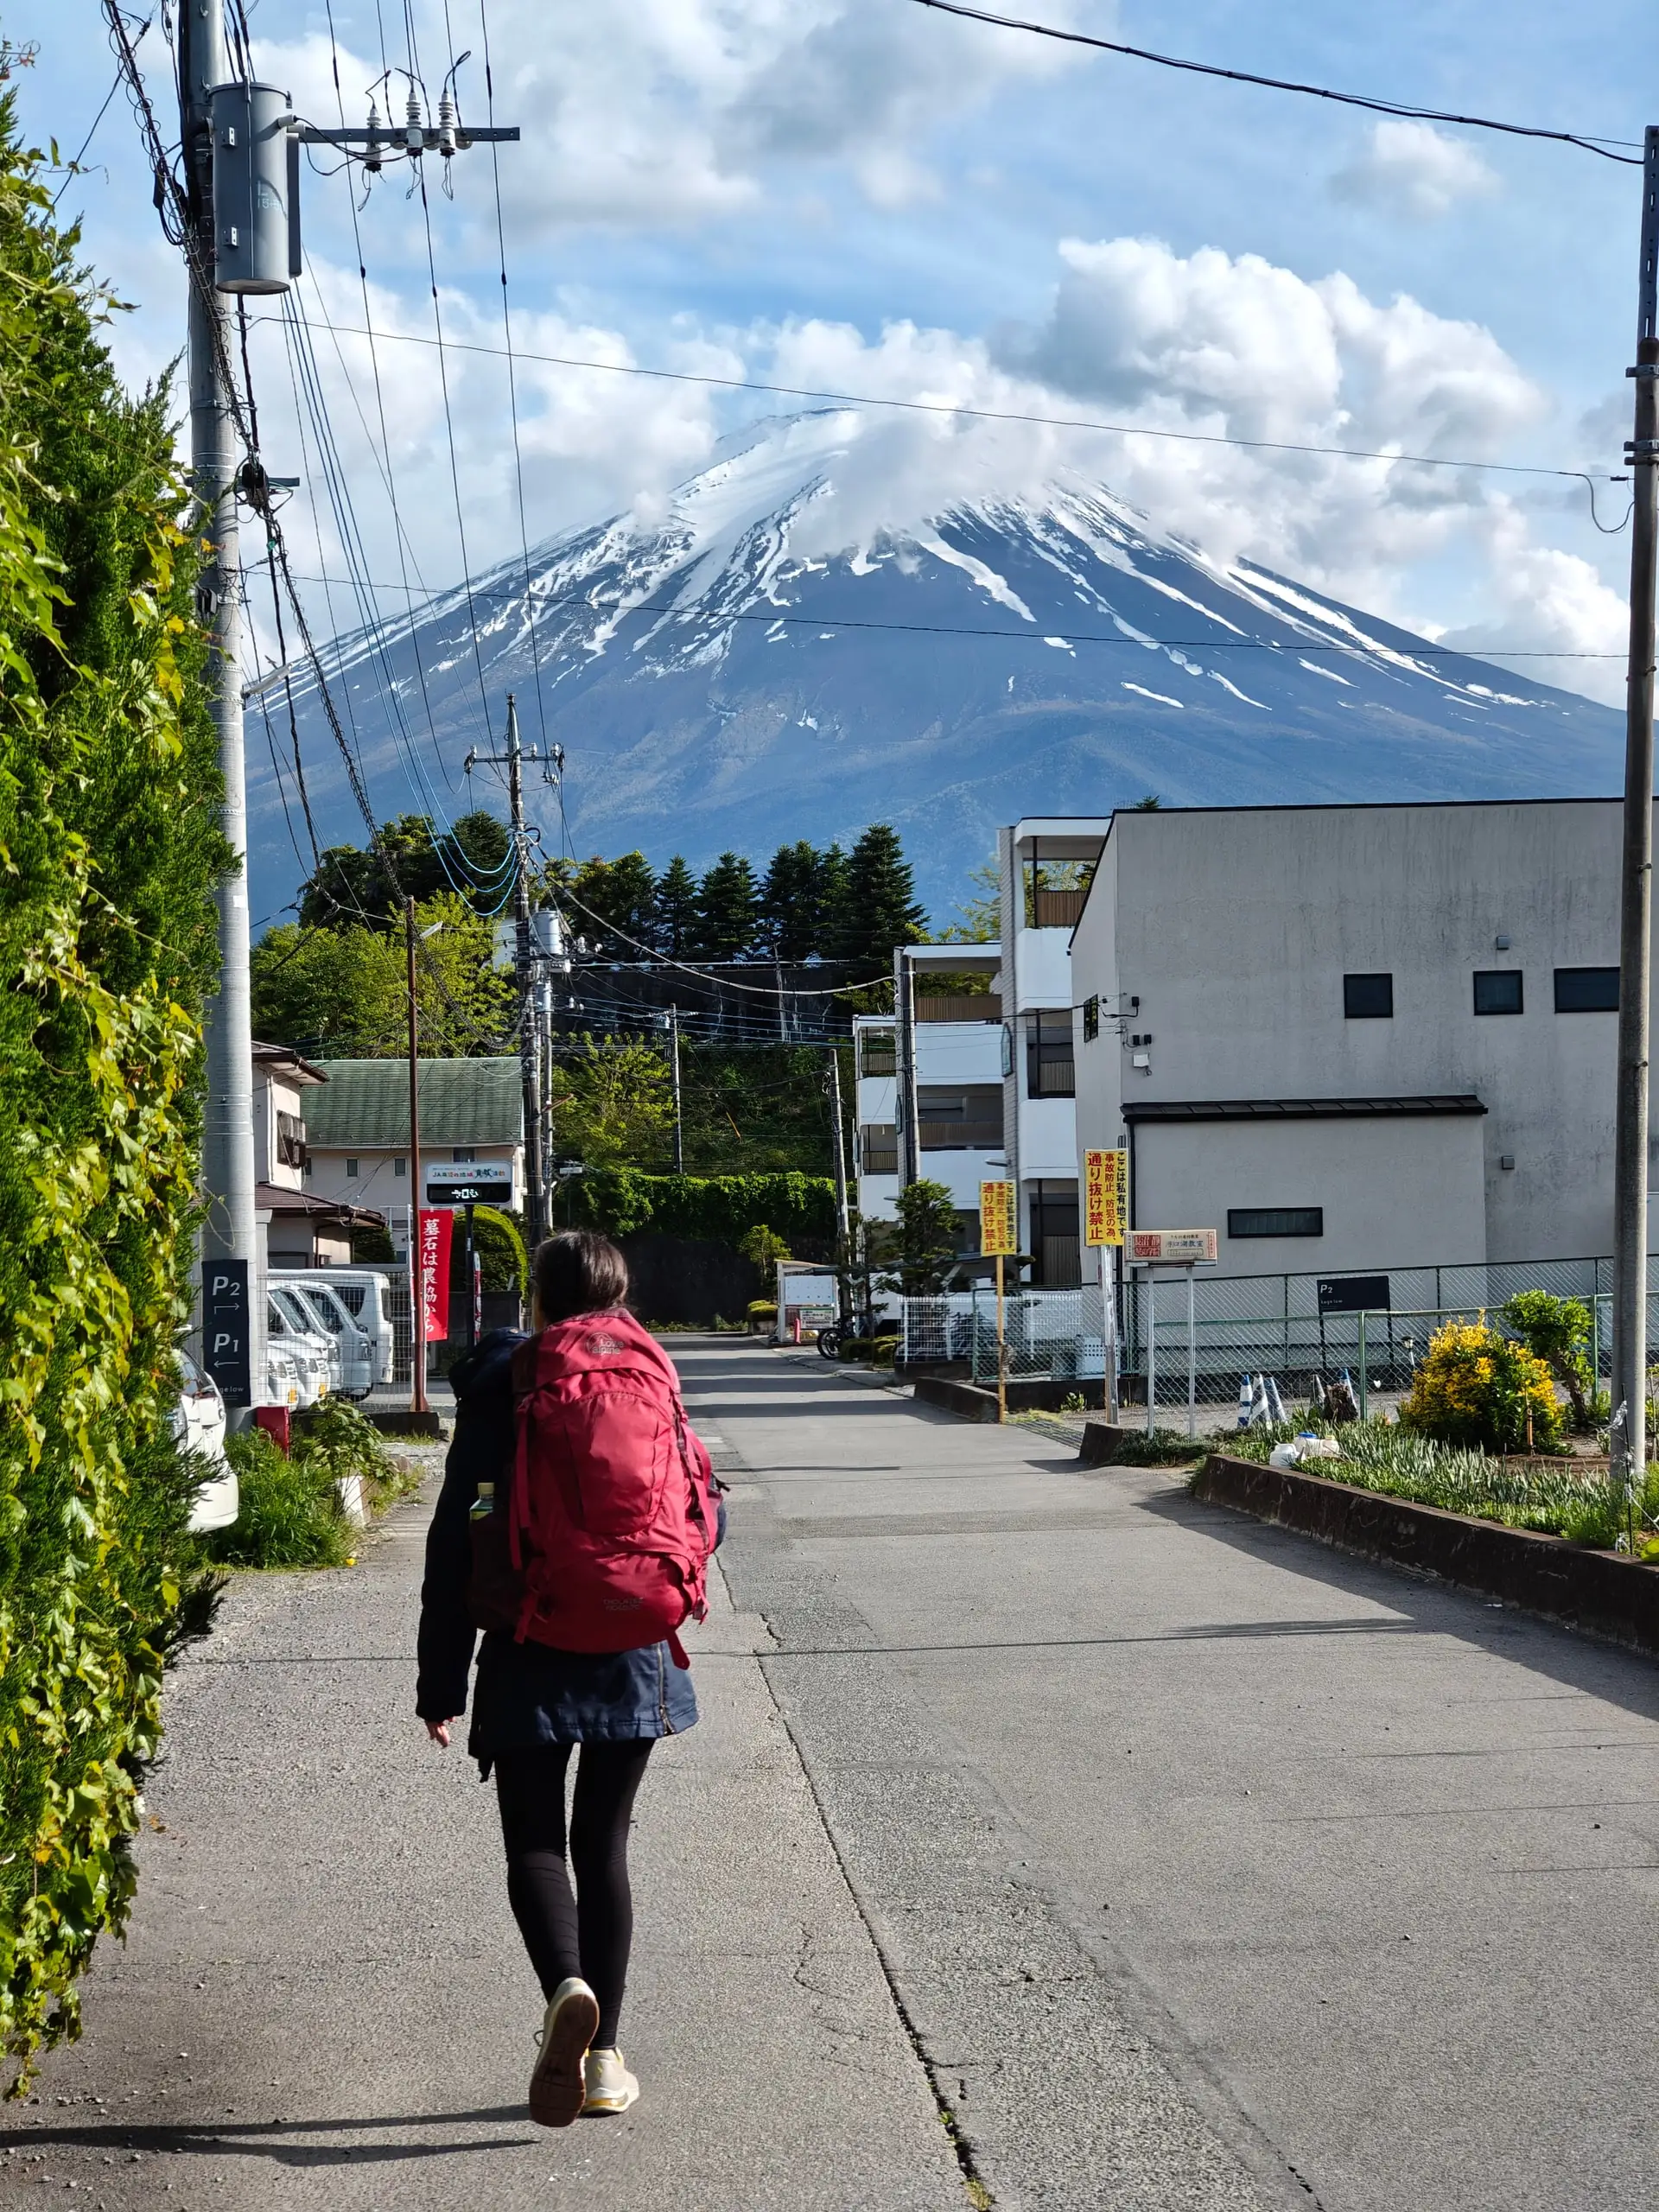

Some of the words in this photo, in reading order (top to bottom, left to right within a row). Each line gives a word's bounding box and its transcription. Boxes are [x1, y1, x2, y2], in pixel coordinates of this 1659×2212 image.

[1088, 1153, 1103, 1241] 通り抜け禁止
[982, 1182, 996, 1252] 通り抜け禁止
[212, 1275, 241, 1296] P2
[422, 1218, 441, 1333] 墓石は農協から
[1320, 1284, 1333, 1294] P2
[213, 1333, 240, 1353] P1
[601, 1338, 624, 1347] Lowe
